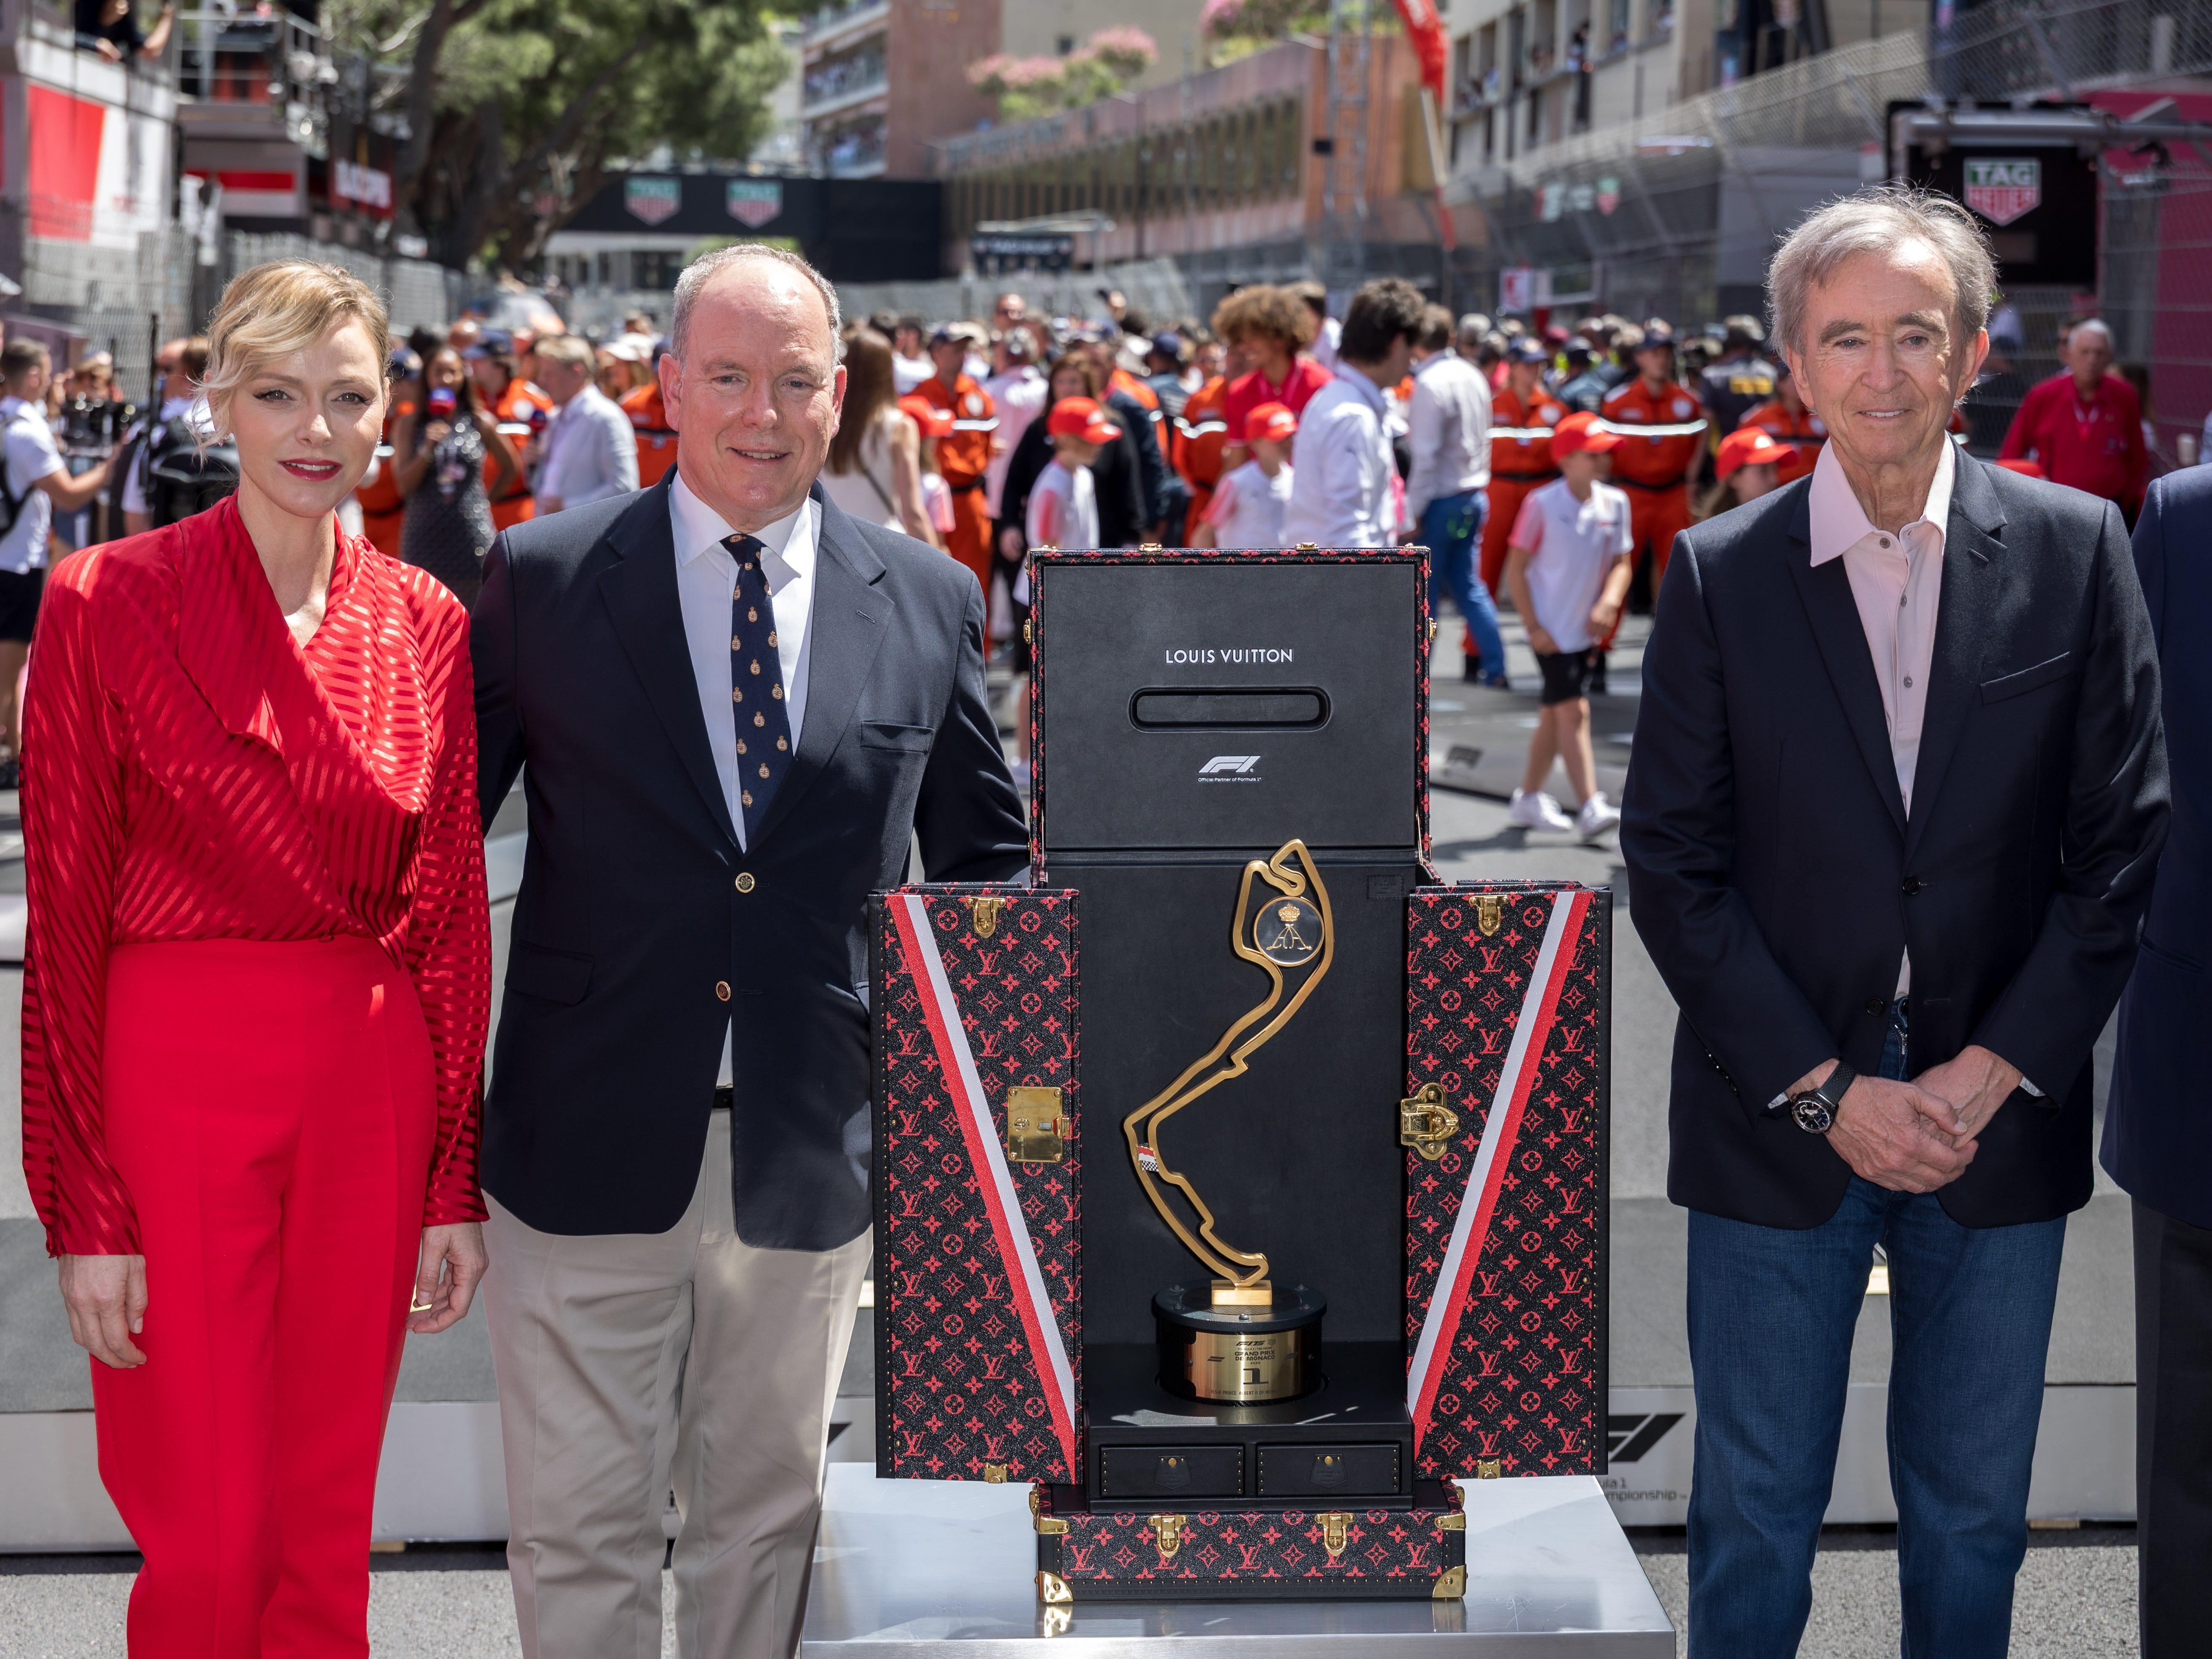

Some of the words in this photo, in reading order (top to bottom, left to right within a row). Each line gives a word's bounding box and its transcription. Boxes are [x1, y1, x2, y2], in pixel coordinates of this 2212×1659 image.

[1975, 167, 2031, 185] TAG
[1166, 649, 1215, 663] LOUIS
[1220, 649, 1293, 663] VUITTON
[1198, 756, 1261, 773] F1
[1243, 1368, 1269, 1385] 1
